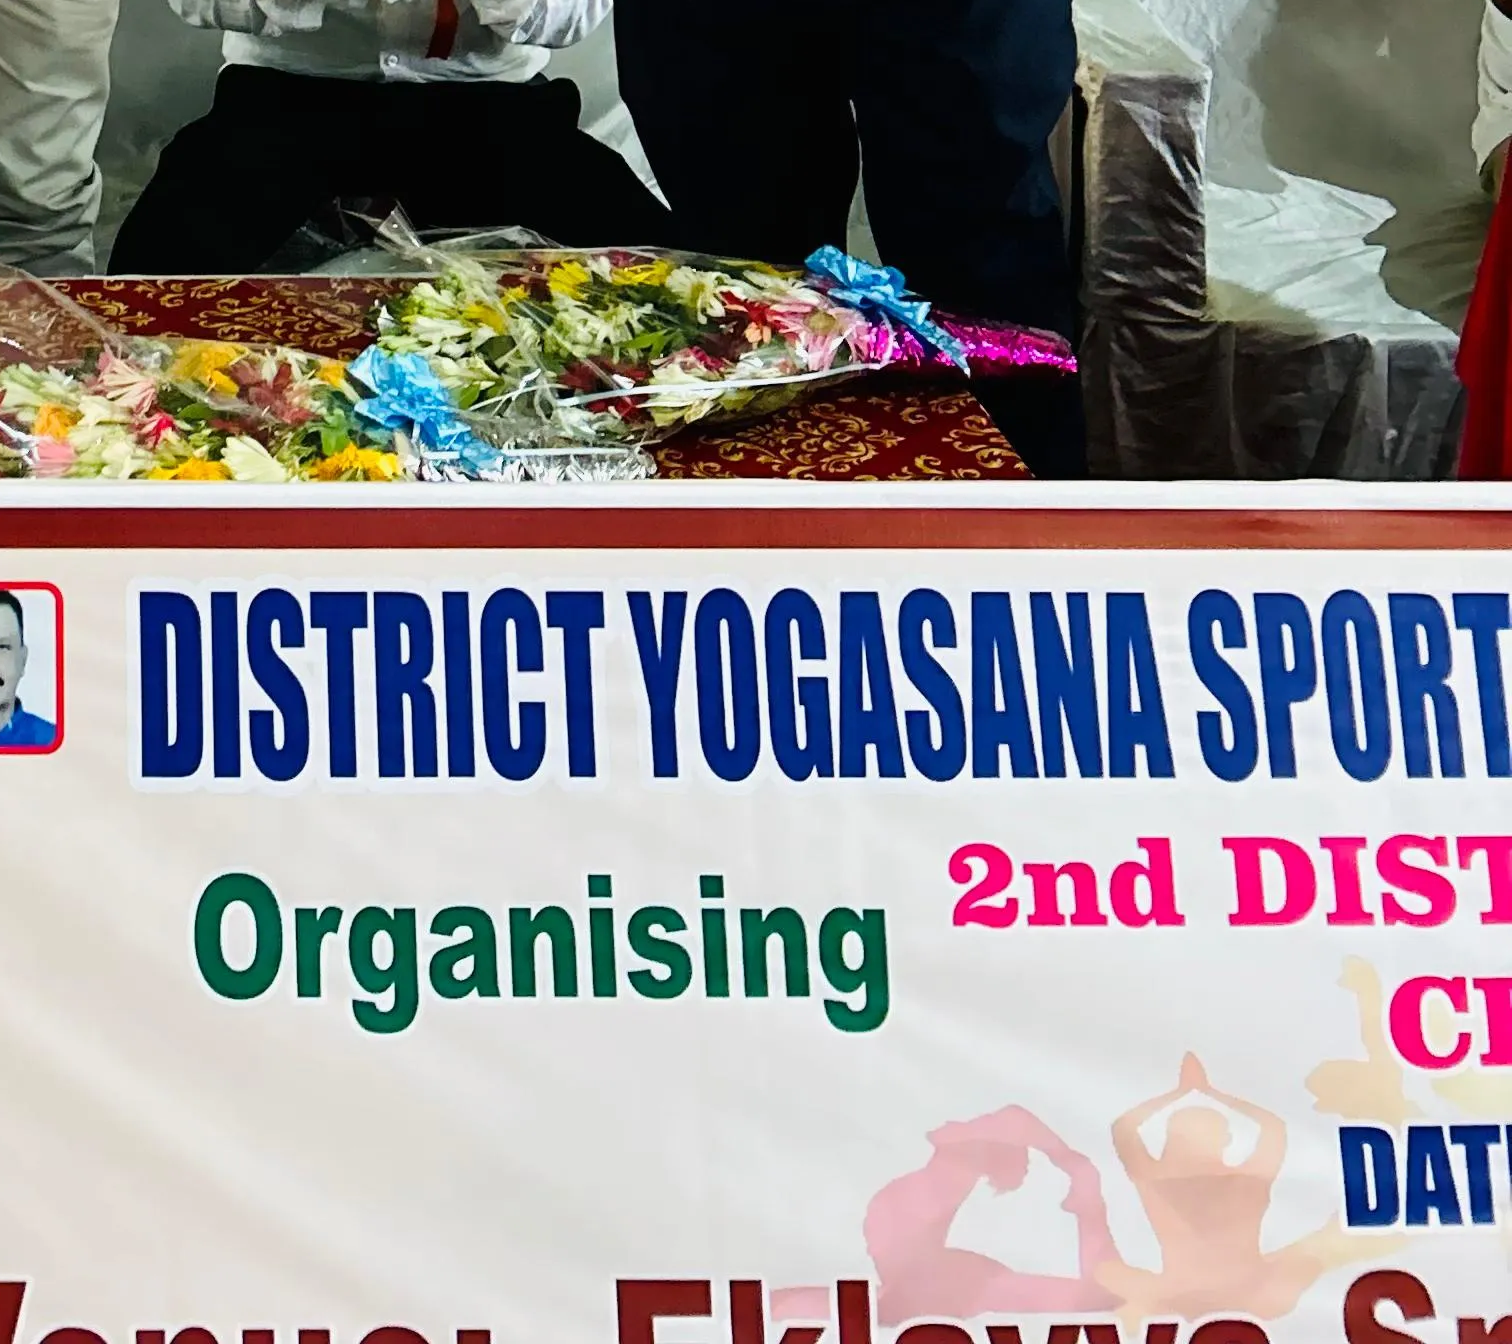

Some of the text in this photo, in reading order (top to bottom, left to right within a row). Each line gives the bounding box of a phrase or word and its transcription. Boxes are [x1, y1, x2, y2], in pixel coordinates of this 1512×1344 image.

[139, 587, 1512, 783] DISTRICT YOGASANA SPORT
[950, 838, 1185, 928] 2nd
[193, 873, 889, 1034] Organising
[1338, 1124, 1512, 1227] DAT
